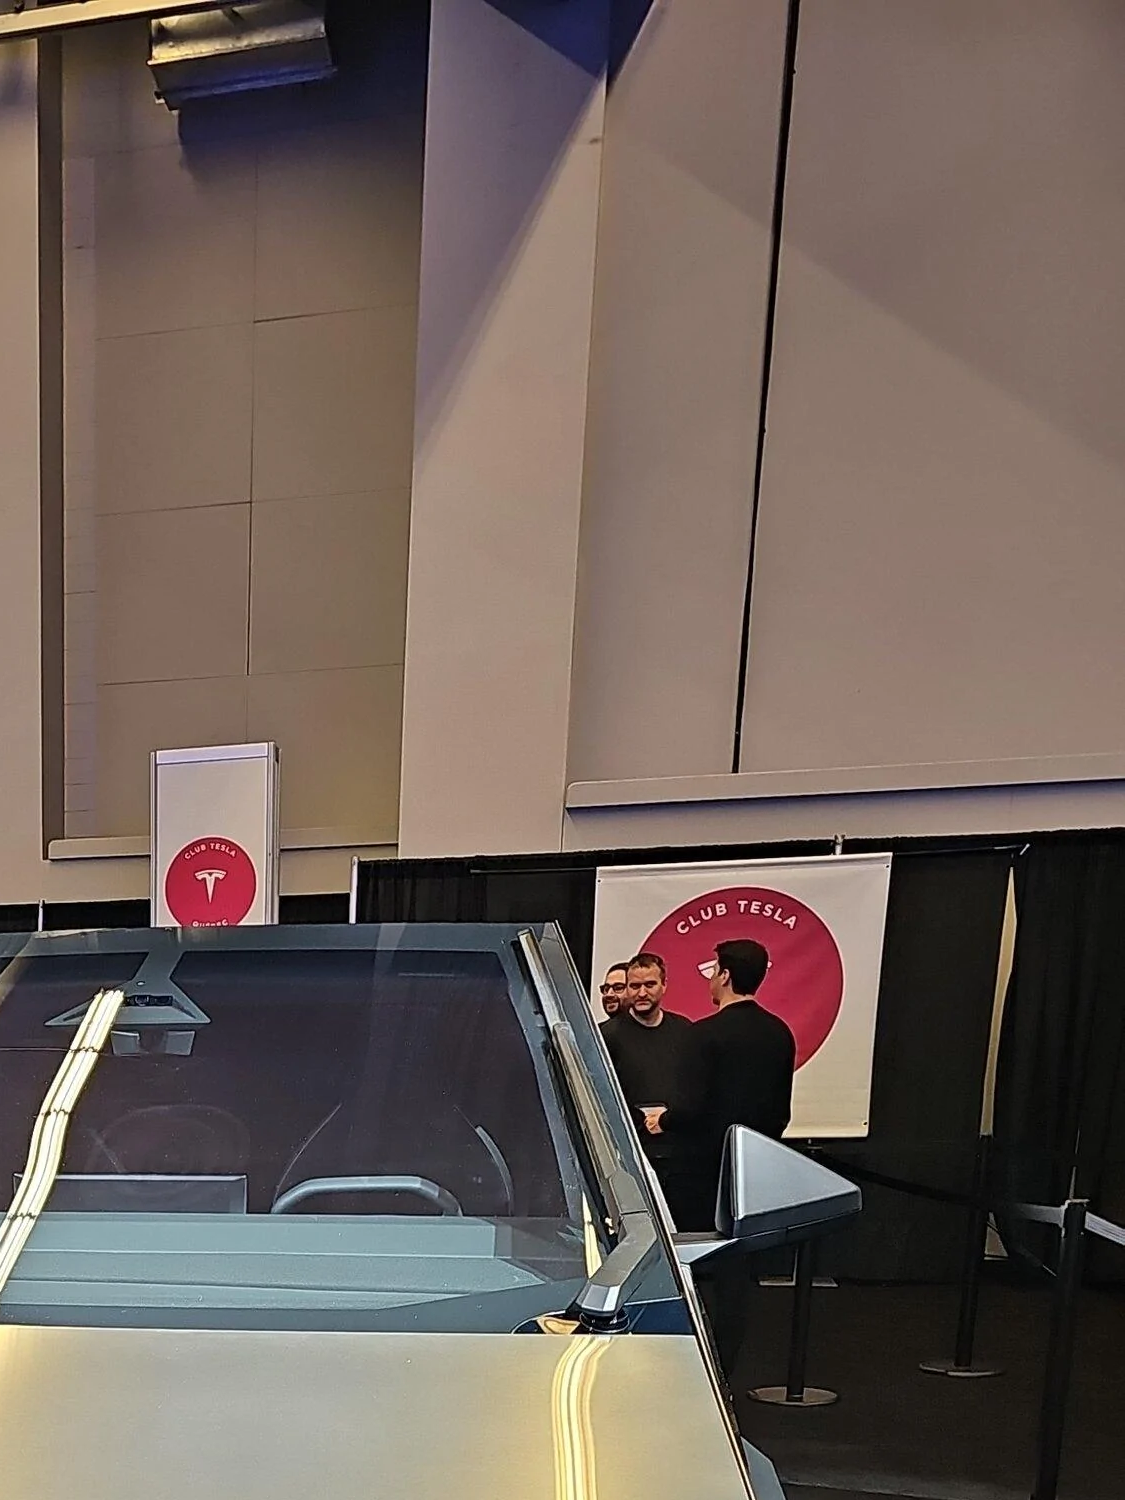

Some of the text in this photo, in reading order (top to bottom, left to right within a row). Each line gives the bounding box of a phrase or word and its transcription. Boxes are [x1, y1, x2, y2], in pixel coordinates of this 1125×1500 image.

[184, 842, 236, 859] CLUB TESLA
[676, 900, 797, 934] CLUB TESLA
